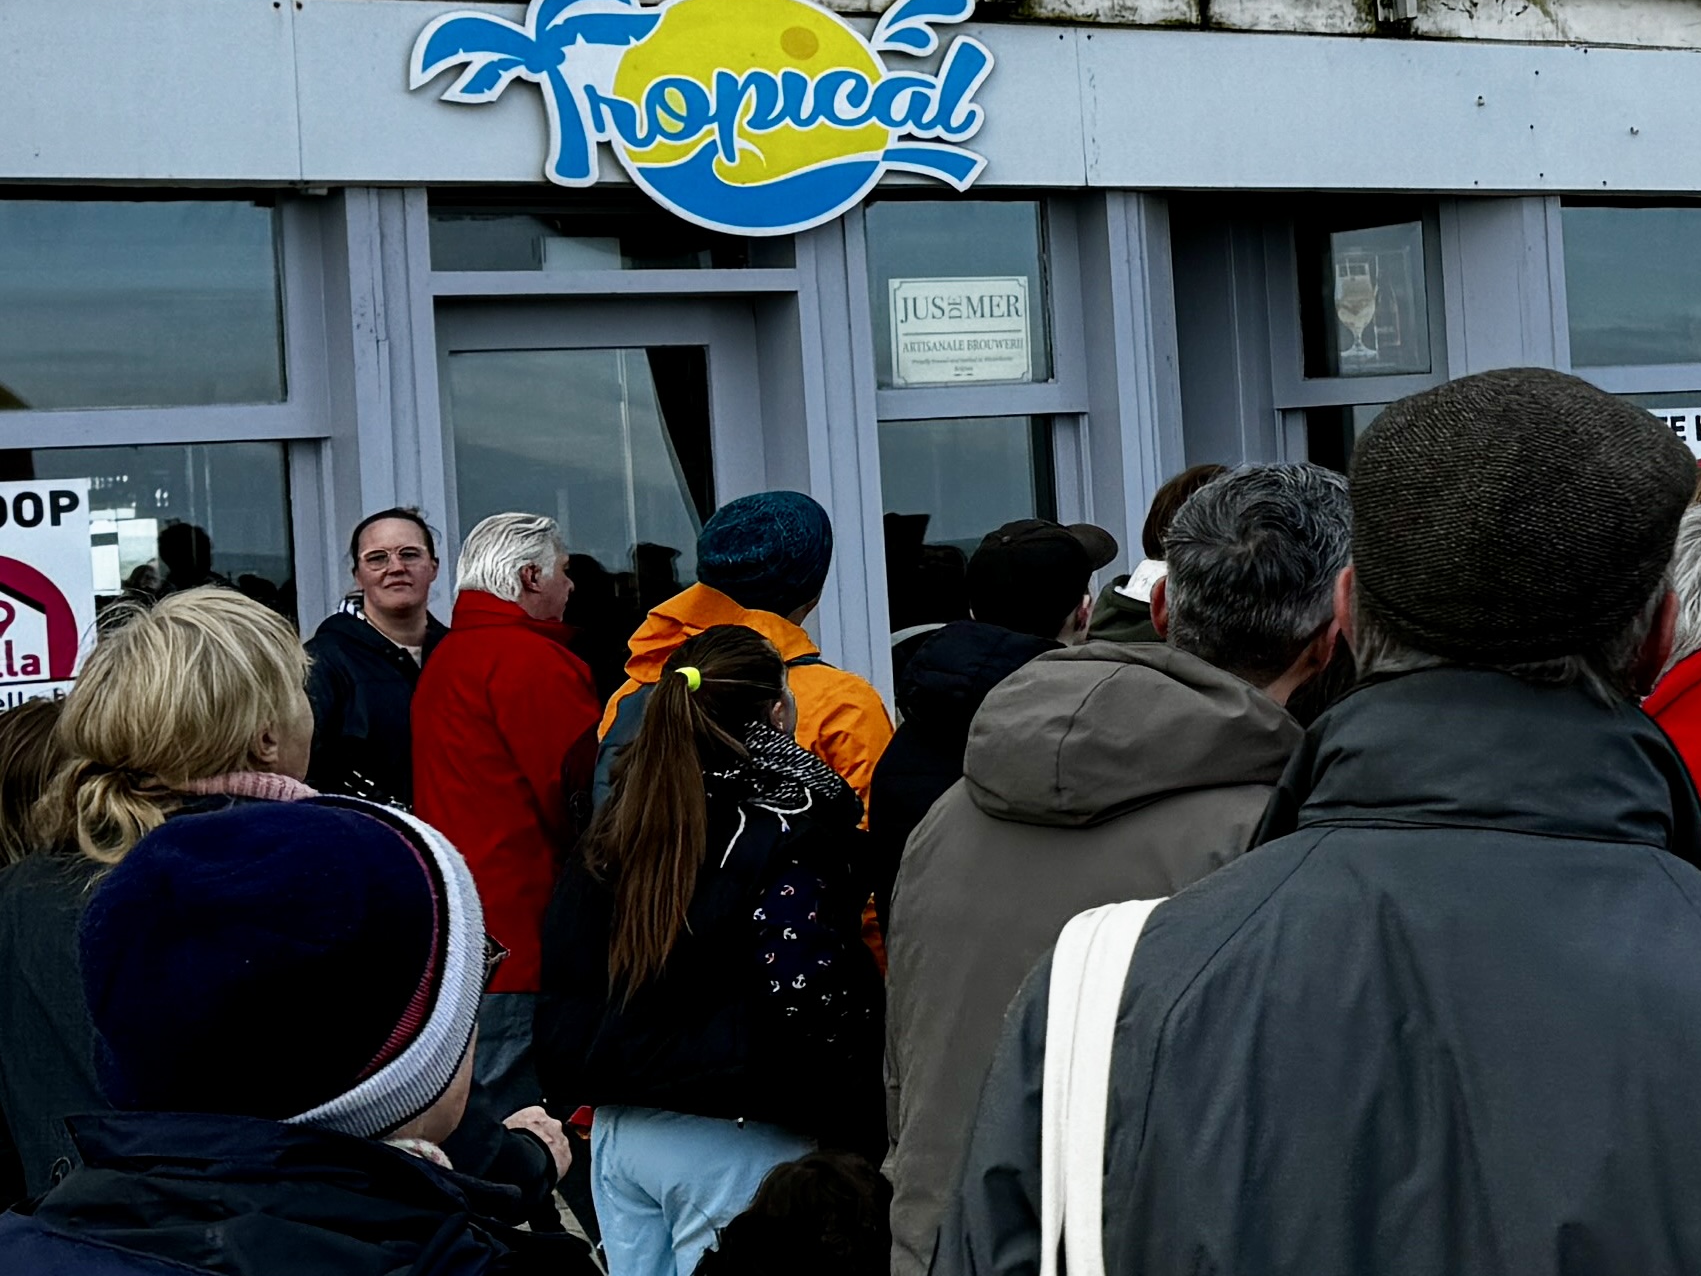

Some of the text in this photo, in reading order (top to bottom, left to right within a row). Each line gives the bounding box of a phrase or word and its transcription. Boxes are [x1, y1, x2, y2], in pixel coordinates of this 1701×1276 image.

[900, 295, 945, 324] JUS
[965, 294, 1022, 319] MER
[902, 339, 964, 353] ARTISANALE
